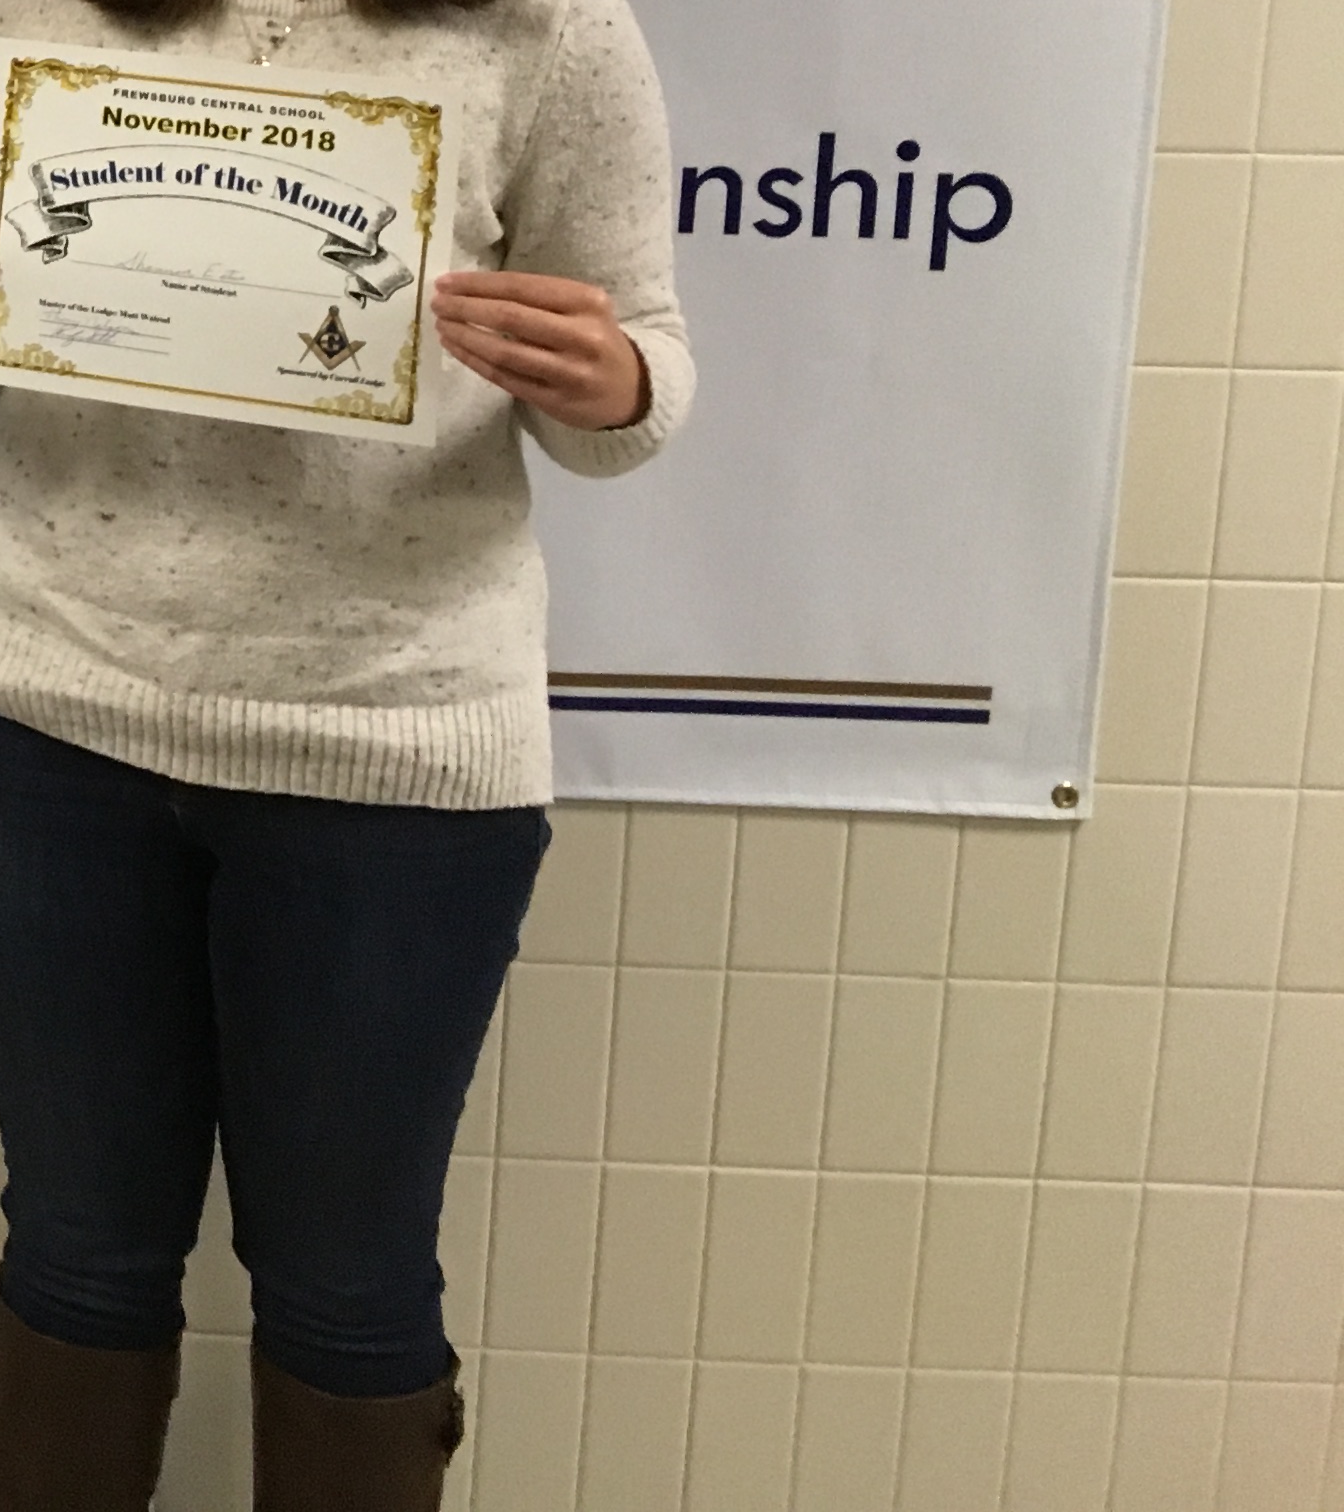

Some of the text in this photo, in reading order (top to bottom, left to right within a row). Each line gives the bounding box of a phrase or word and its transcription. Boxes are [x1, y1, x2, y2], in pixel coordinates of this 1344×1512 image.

[112, 88, 326, 121] FREWSBURG CENTRAL SCHOOL
[101, 105, 336, 153] November 2018
[50, 161, 369, 234] Student of the Month
